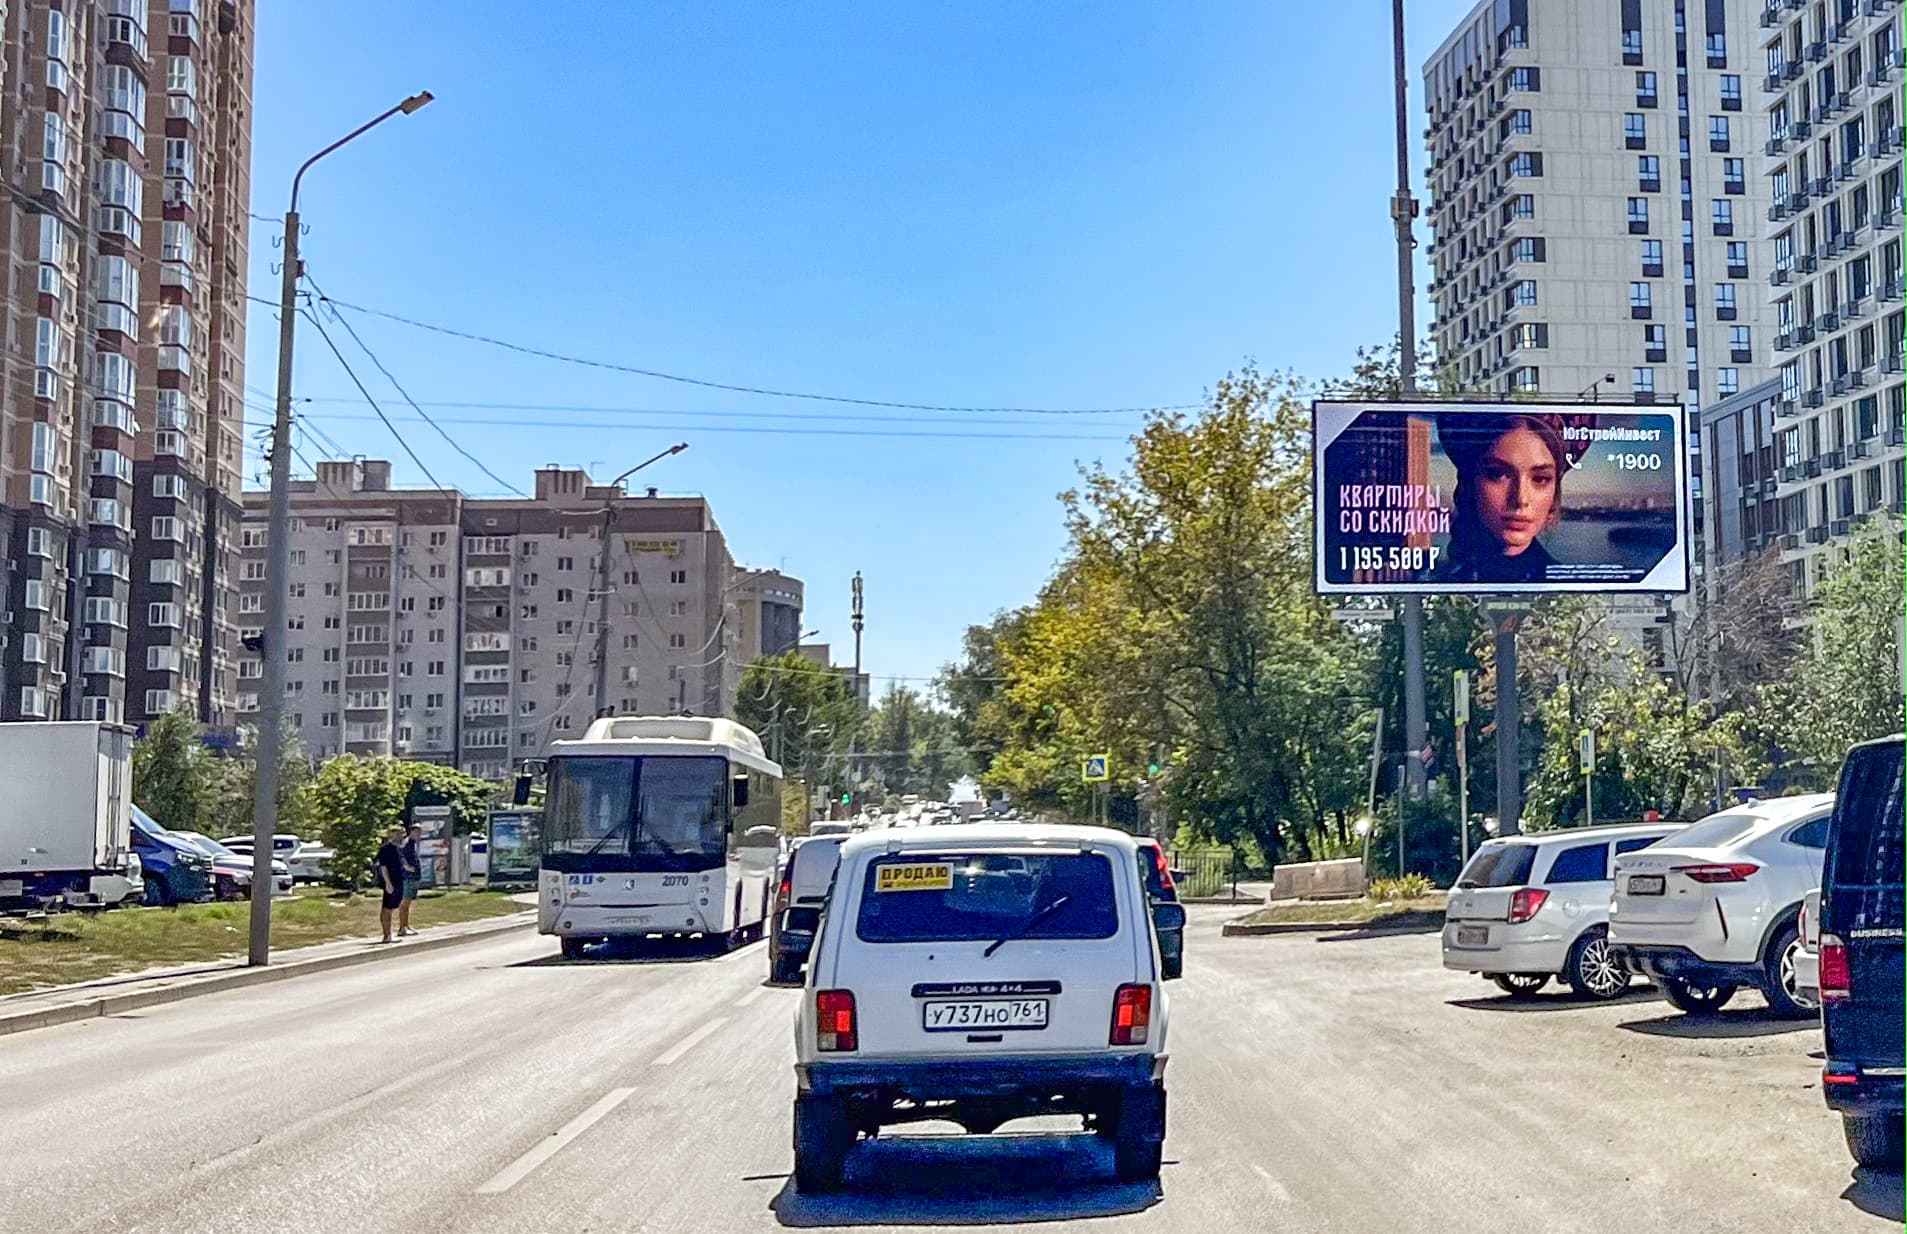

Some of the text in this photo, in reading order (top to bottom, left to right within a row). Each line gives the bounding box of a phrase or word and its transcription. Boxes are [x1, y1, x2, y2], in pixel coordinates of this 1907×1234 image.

[1563, 426, 1661, 442] ЮгСтройИнвест
[1339, 484, 1441, 508] КВАРТИРЫ
[1339, 507, 1451, 537] СО СКИДКОЙ
[661, 875, 689, 887] 2070
[881, 866, 949, 881] ПРОДАЮ
[952, 985, 978, 994] LADA
